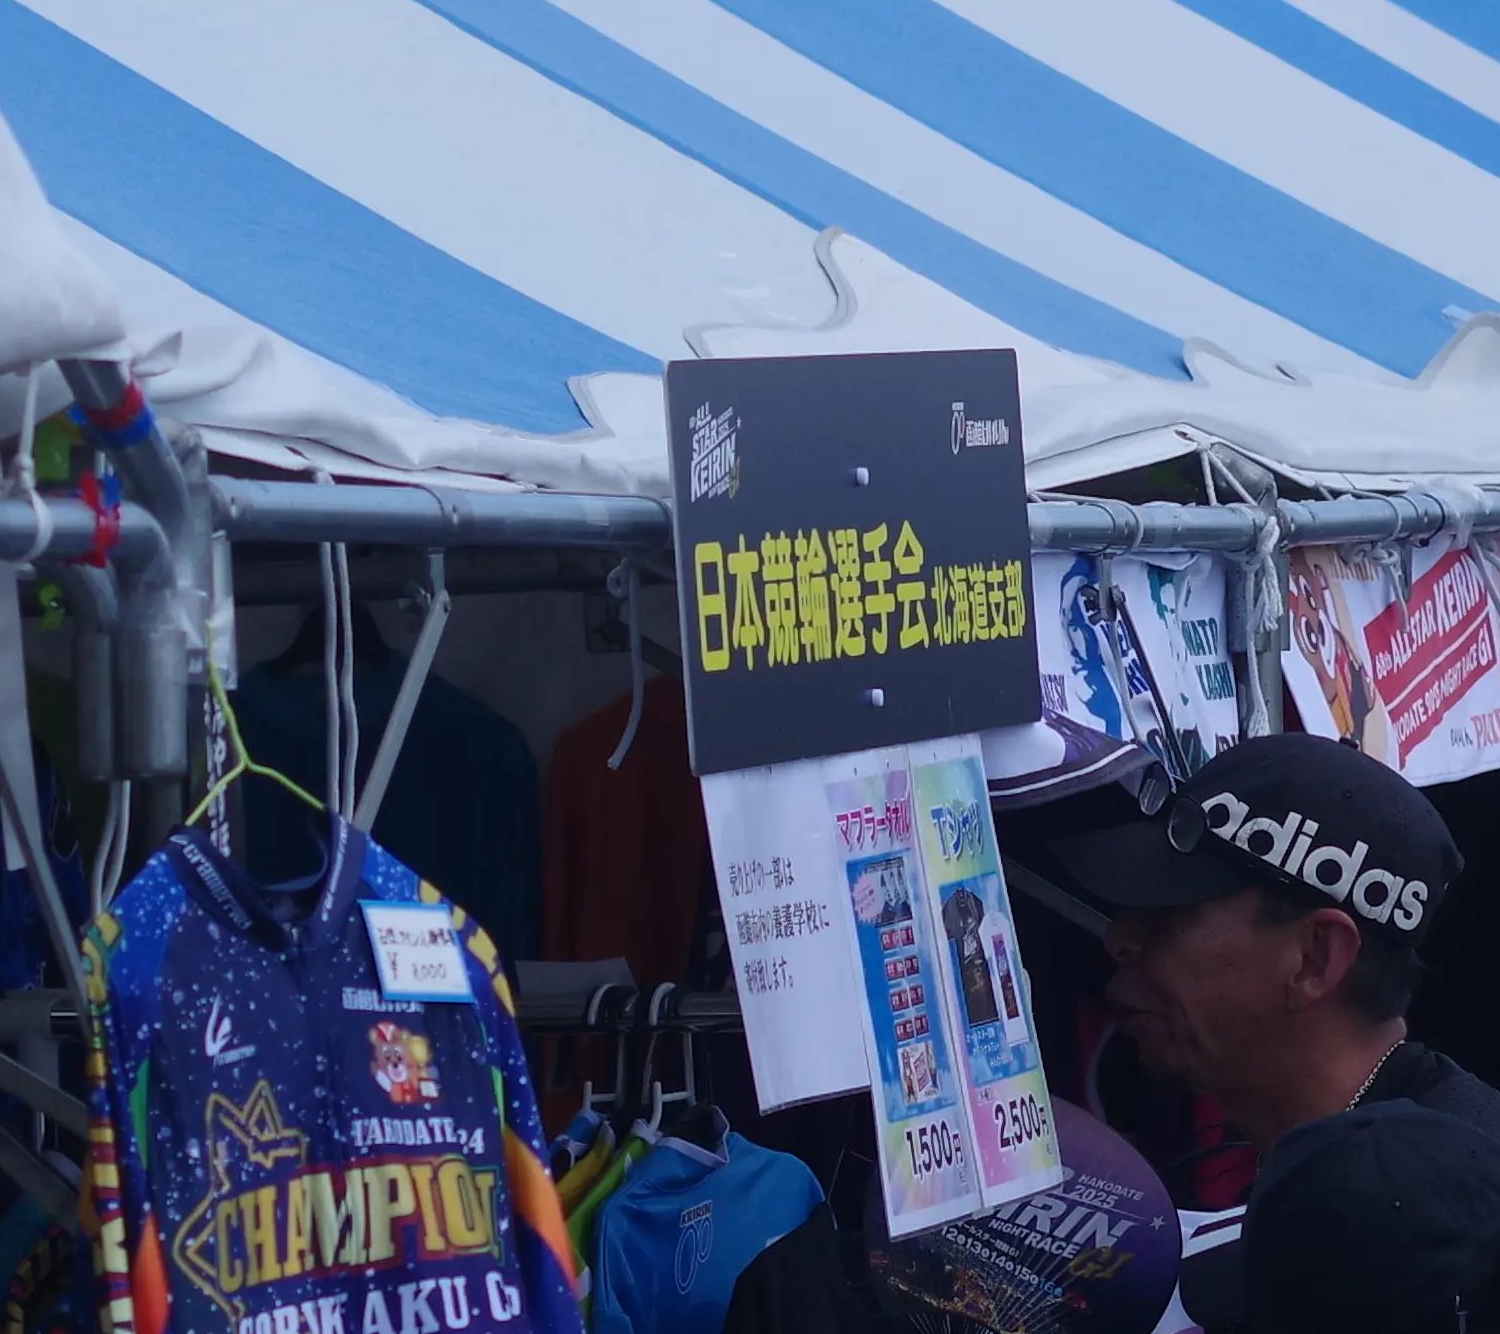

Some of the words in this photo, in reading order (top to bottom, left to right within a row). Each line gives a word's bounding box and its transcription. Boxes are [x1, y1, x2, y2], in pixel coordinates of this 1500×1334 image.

[695, 519, 930, 672] 日本競輪選手会
[931, 560, 1026, 646] 北海道支部
[1200, 791, 1428, 932] adidas
[905, 1120, 964, 1179] 1,500円
[993, 1093, 1051, 1153] 2,500円
[1072, 1184, 1120, 1209] 2025
[1077, 1173, 1145, 1201] HAKODATE
[988, 1217, 1028, 1240] NIGHT
[1023, 1227, 1082, 1260] RACE
[997, 1194, 1141, 1250] IRIN
